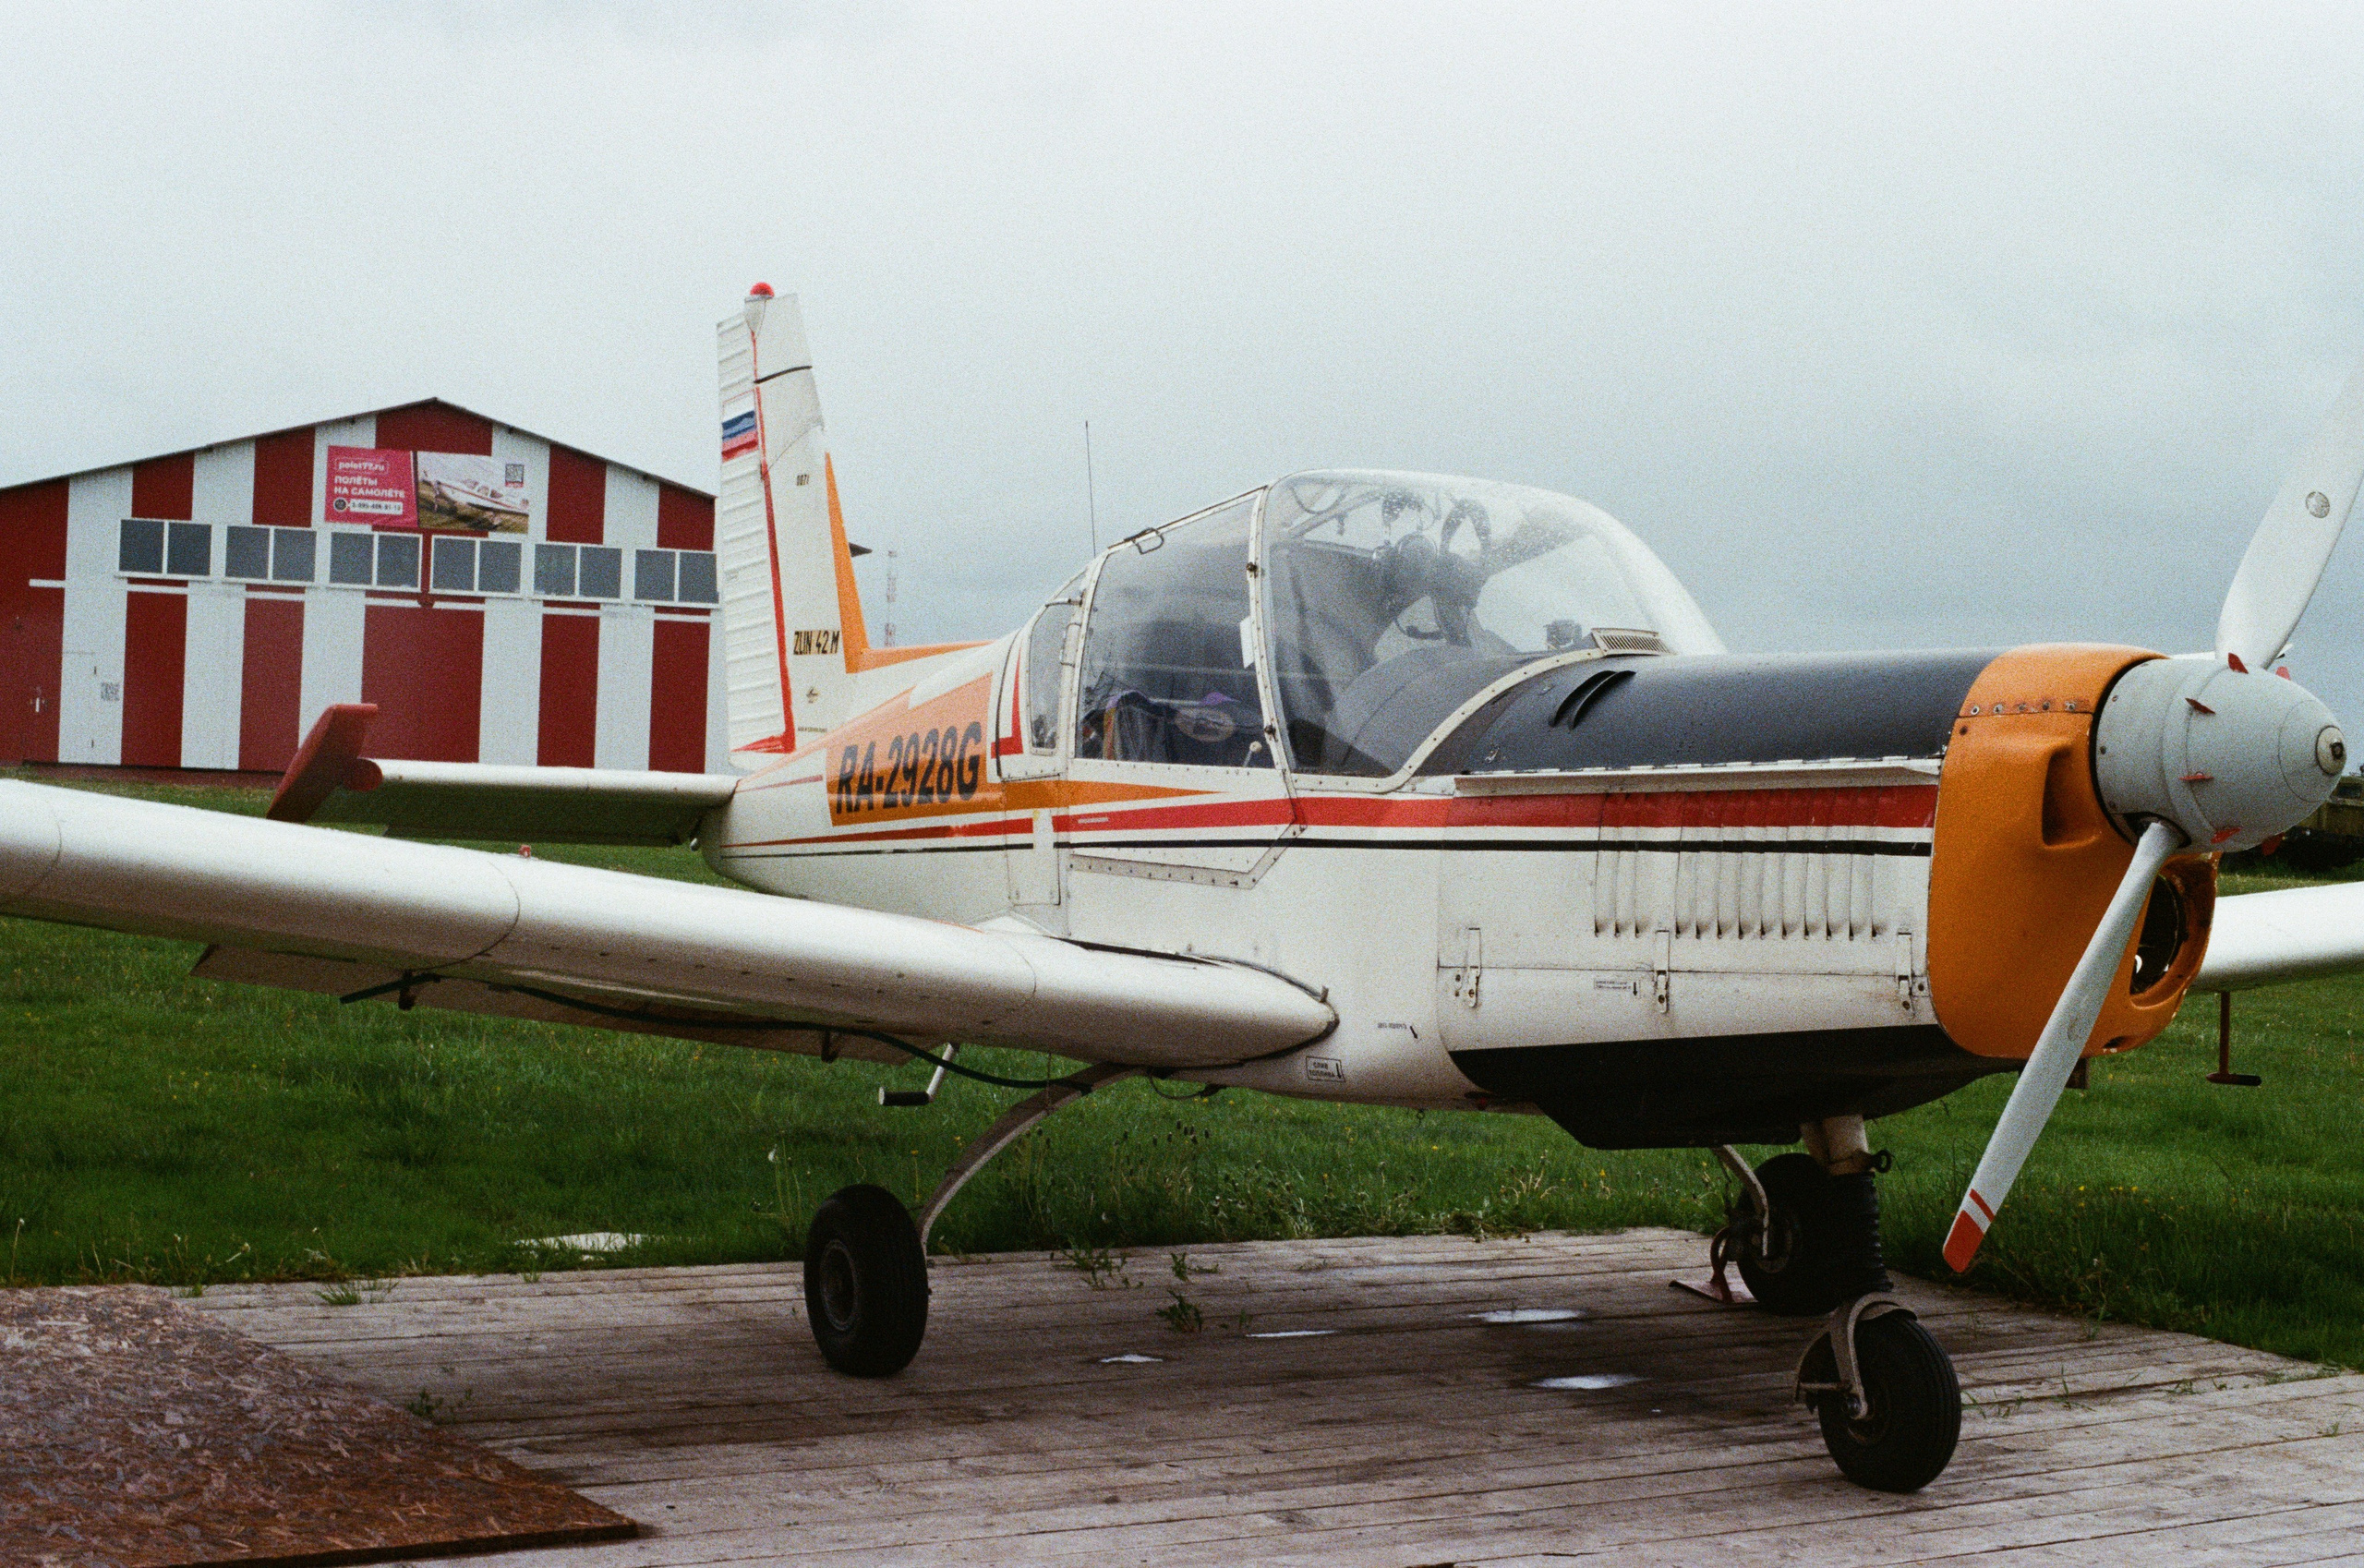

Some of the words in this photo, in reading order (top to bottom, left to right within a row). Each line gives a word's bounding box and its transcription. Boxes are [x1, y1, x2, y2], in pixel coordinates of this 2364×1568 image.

[333, 487, 349, 495] НА
[793, 630, 813, 655] ZLIN
[815, 630, 829, 655] 42
[830, 630, 840, 654] M
[836, 721, 982, 814] RA-2928G
